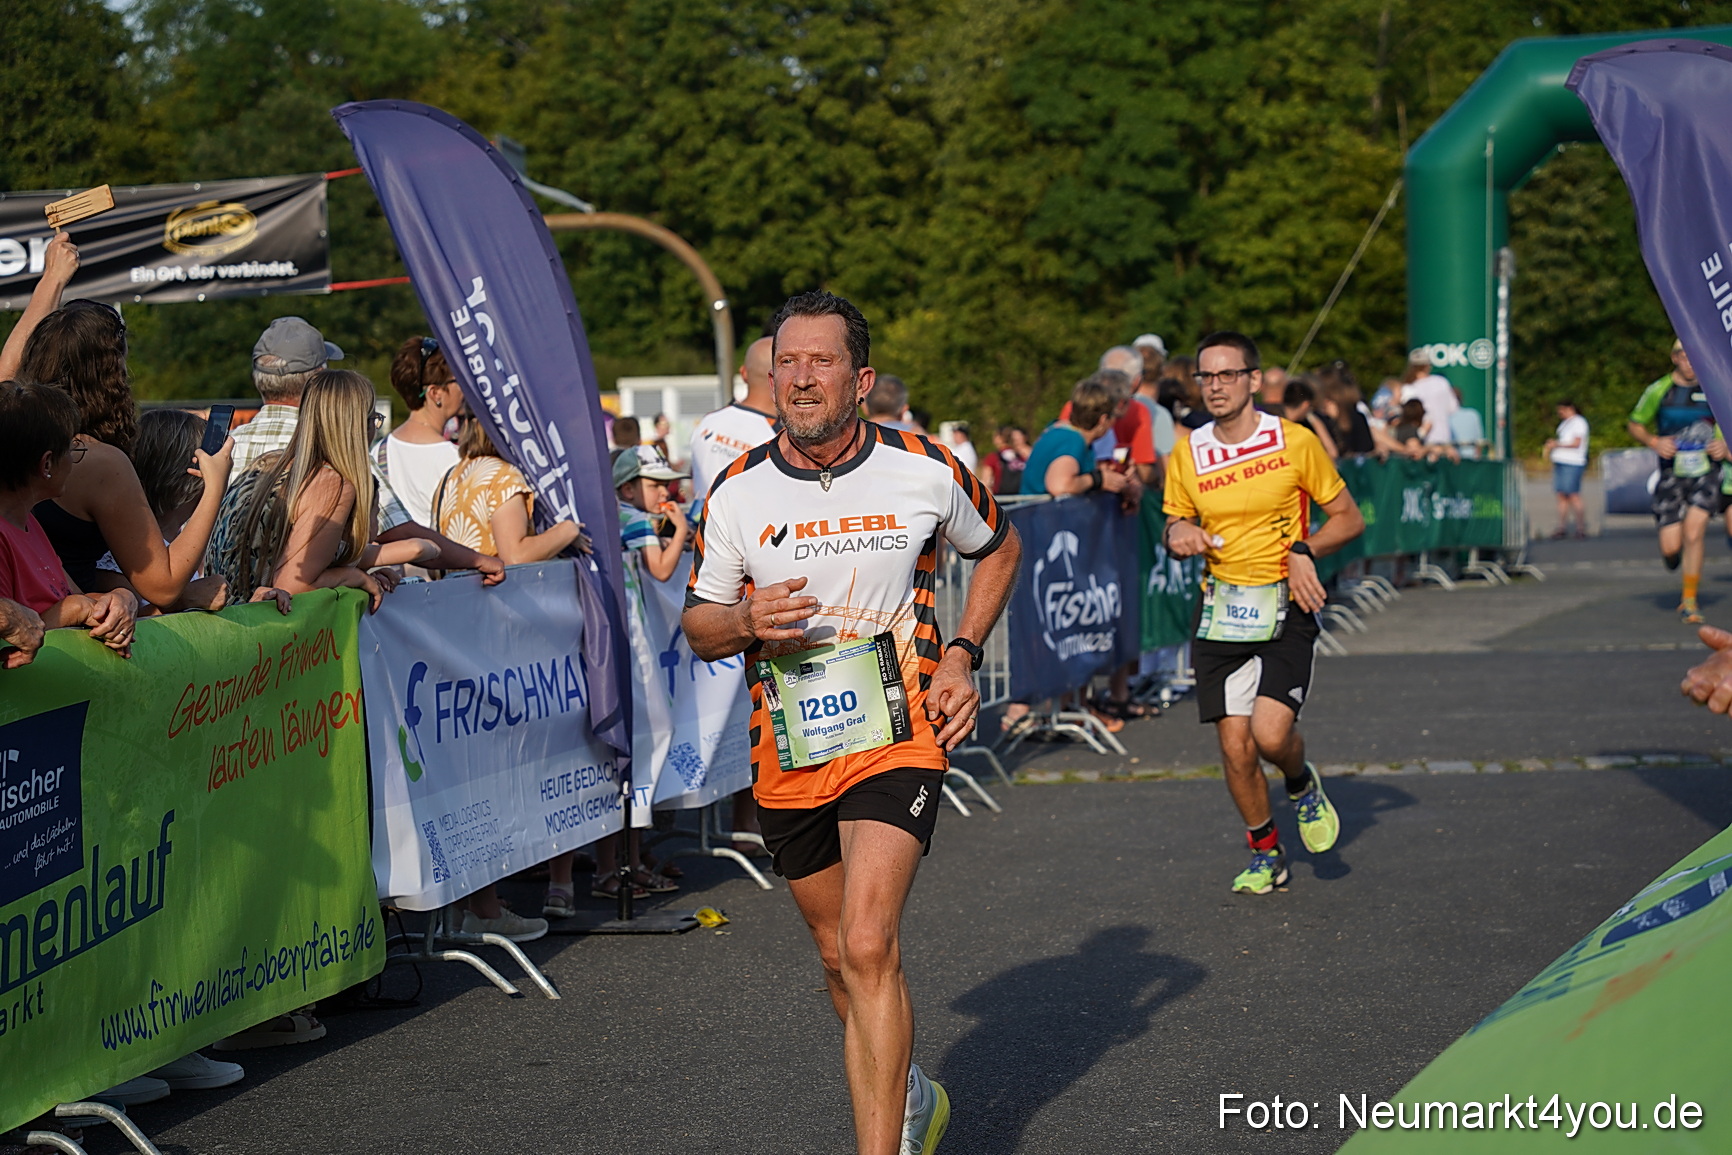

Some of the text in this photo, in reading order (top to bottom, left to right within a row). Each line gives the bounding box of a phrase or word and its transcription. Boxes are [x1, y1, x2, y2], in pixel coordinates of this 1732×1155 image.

[130, 261, 299, 283] Ein Ort, der verbindet.
[1422, 343, 1469, 369] OK
[1198, 457, 1290, 493] MAX BÖGL
[795, 514, 908, 540] KLEBL
[794, 535, 909, 560] DYNAMICS
[1226, 604, 1259, 620] 1824
[168, 628, 341, 739] Gesunde Firmen
[799, 690, 858, 722] 1280
[892, 702, 903, 735] HILTL
[207, 688, 362, 793] laufen länger
[802, 722, 845, 737] Wolfgang
[846, 714, 867, 727] Graf
[0, 765, 65, 812] ischer
[540, 761, 620, 802] HEUTE GEDACH
[0, 795, 60, 830] AUTOMOBILE
[460, 799, 492, 826] LOGISTICS
[544, 803, 586, 837] MORGEN
[30, 833, 46, 851] das
[100, 906, 376, 1051] www.firmenlauf-oberpfalz.de
